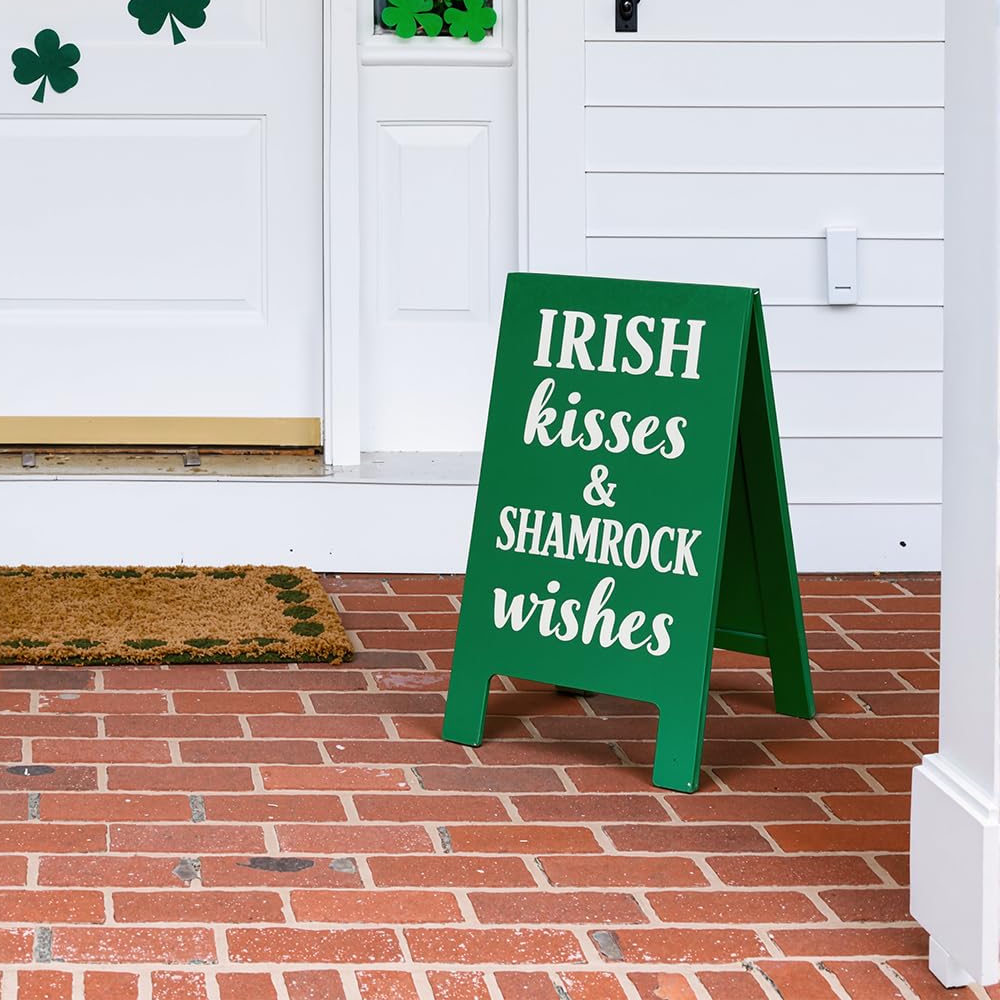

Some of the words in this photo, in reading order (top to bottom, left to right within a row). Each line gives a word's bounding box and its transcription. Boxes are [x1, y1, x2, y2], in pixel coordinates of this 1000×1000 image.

[533, 308, 707, 380] IRISH
[523, 377, 688, 460] kisses
[582, 464, 617, 508] &
[495, 505, 703, 577] SHAMROCK
[493, 576, 674, 657] wishes
